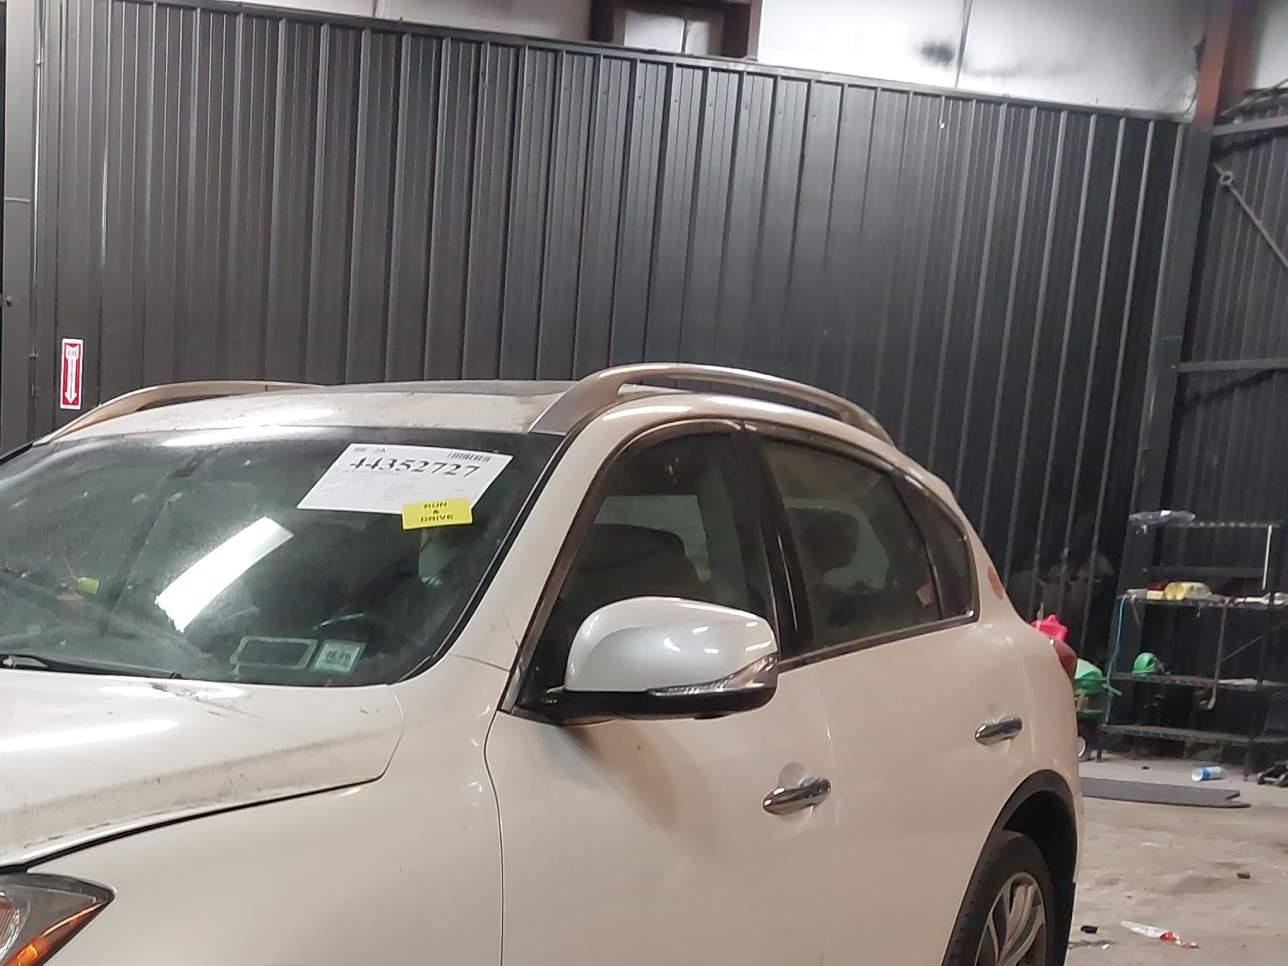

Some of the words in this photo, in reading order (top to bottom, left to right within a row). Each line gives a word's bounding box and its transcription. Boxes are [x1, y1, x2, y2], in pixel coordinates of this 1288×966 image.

[349, 456, 480, 477] 44352727
[423, 501, 448, 509] RUN
[420, 514, 454, 523] DRIVE
